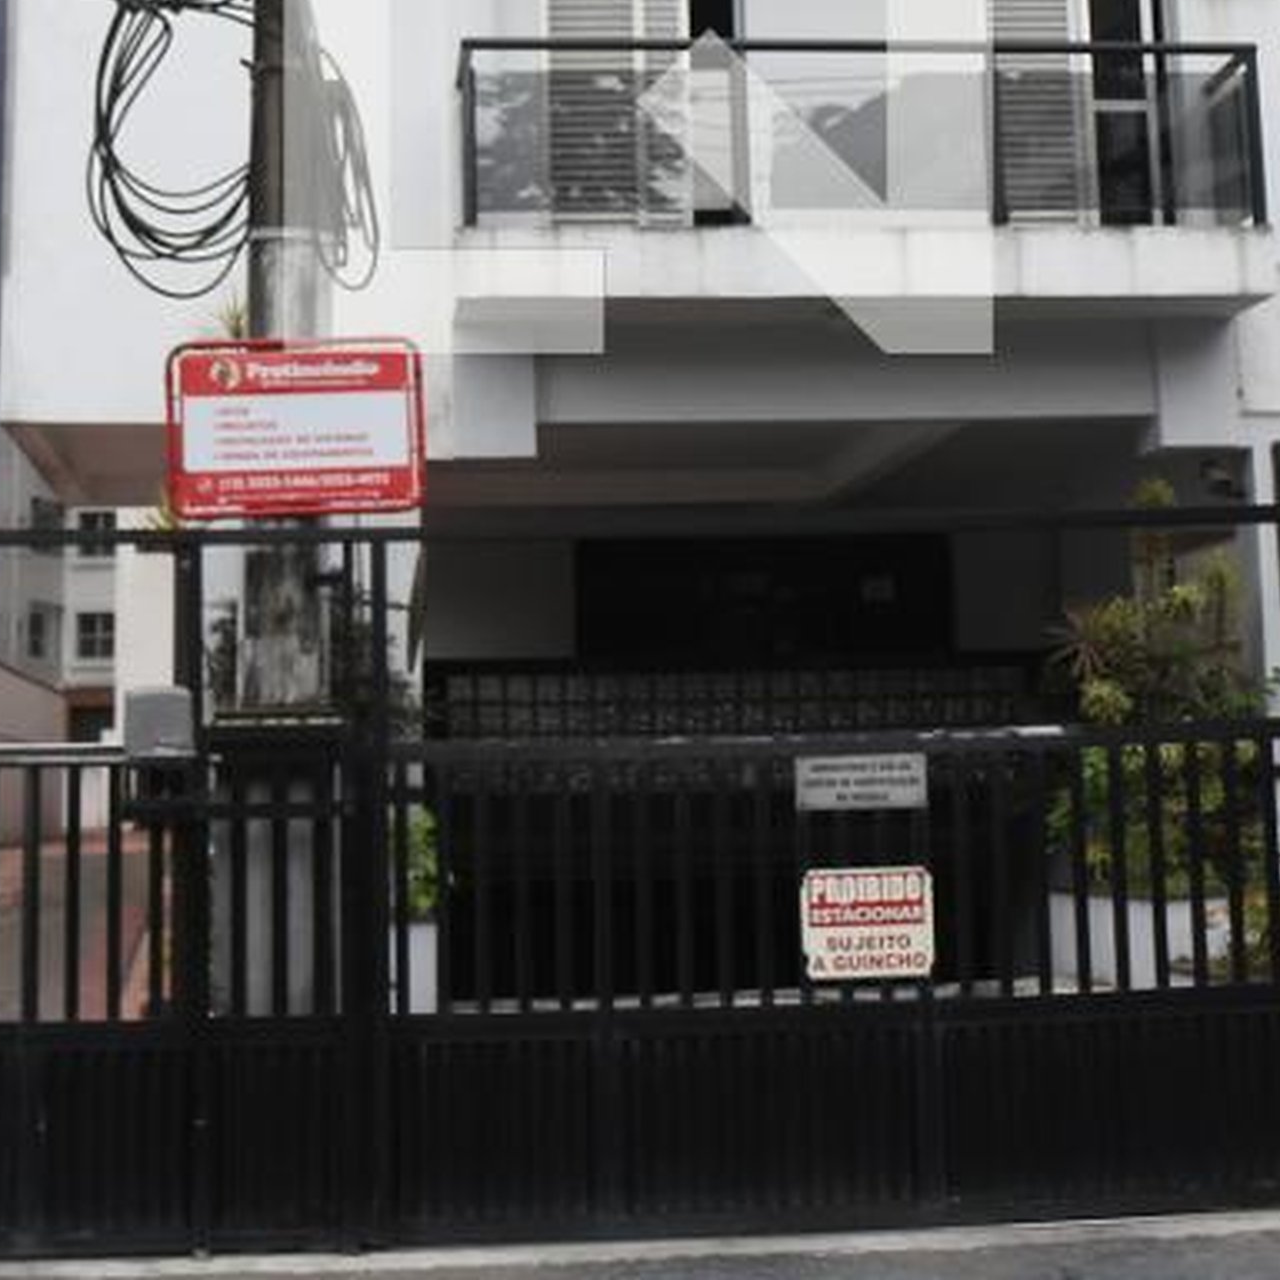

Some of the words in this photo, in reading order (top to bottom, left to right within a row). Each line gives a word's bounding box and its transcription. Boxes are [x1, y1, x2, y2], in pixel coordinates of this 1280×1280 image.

[811, 873, 922, 904] PROIBIDO
[811, 905, 922, 924] ESTACIONAR
[826, 933, 912, 952] SUJEITO
[813, 955, 826, 972] A
[832, 952, 928, 971] GUINCHO
